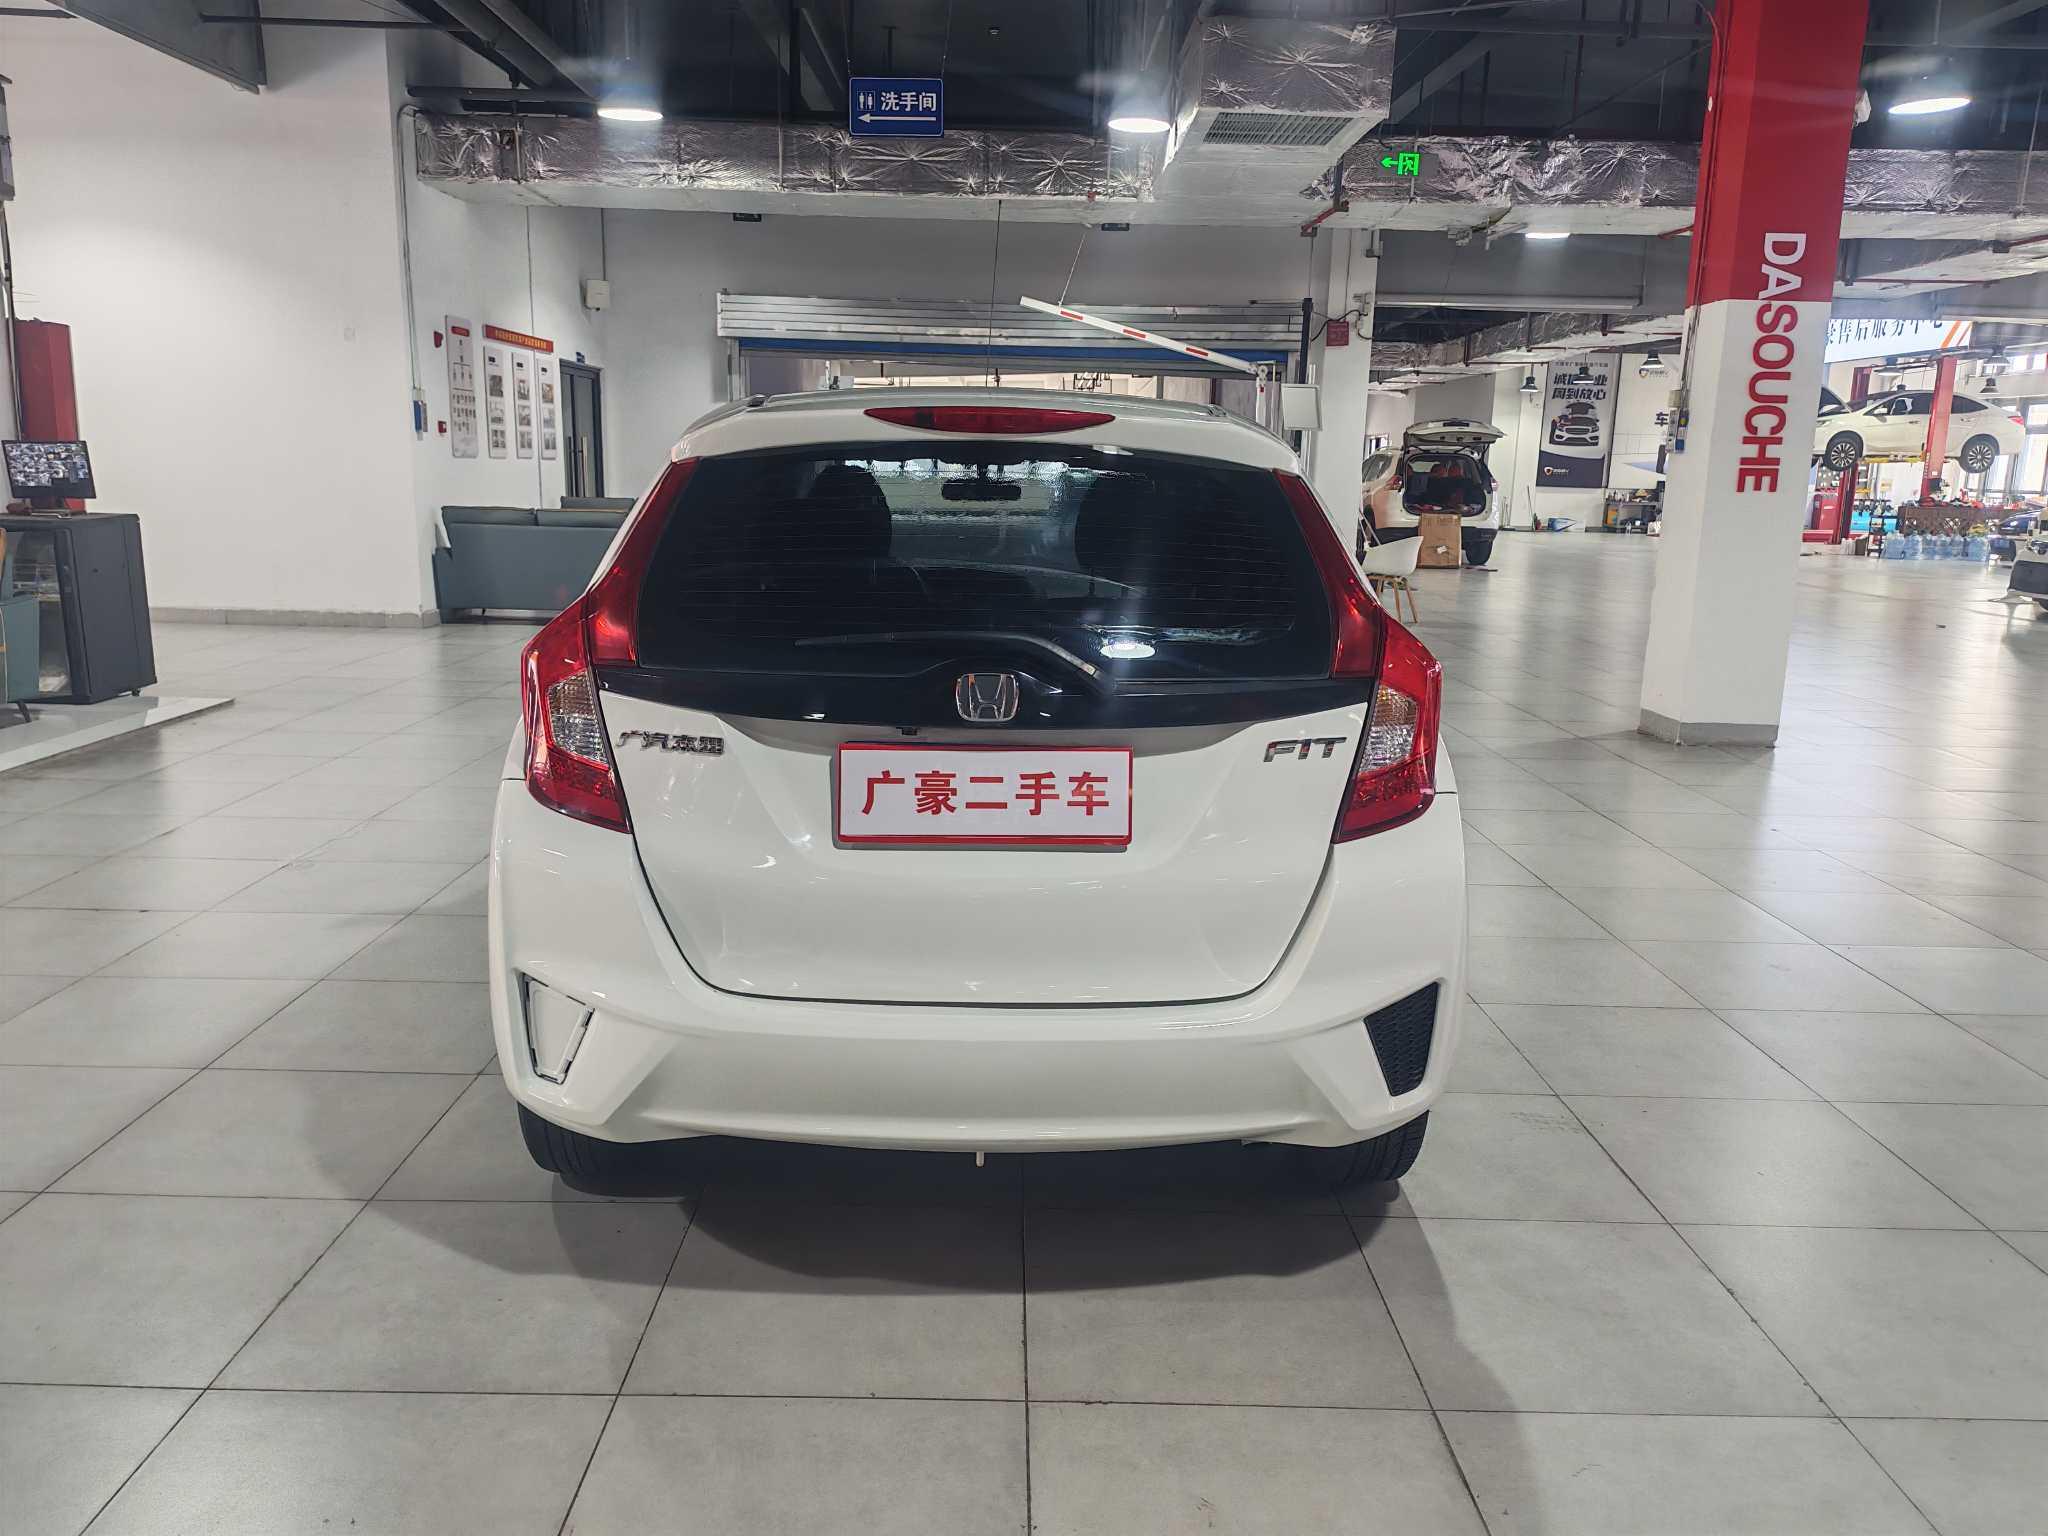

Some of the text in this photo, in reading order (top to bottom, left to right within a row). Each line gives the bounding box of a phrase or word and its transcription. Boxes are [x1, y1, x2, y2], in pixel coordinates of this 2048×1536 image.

[881, 91, 937, 112] 洗手间
[1736, 232, 1807, 493] DASOUCHE
[1553, 372, 1609, 386] 诚业
[1263, 737, 1347, 763] FIT
[861, 770, 1110, 816] 广豪二手车
